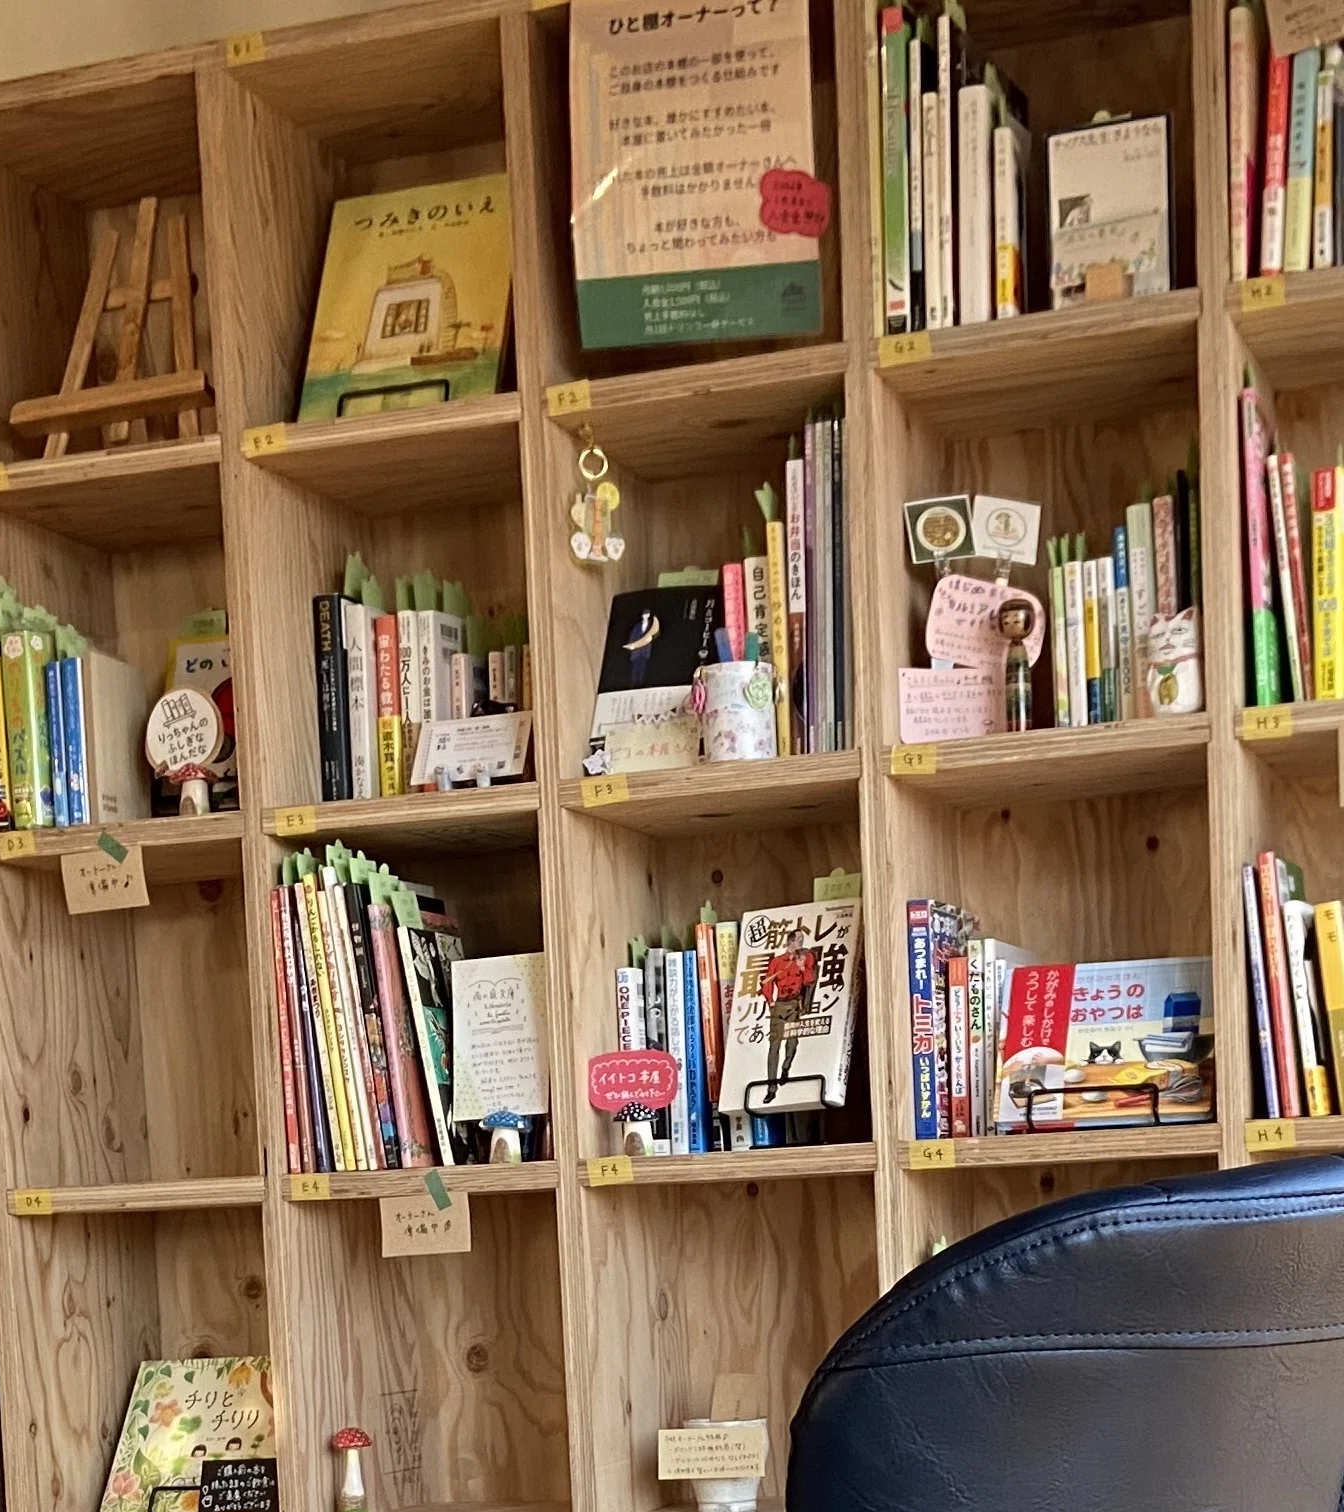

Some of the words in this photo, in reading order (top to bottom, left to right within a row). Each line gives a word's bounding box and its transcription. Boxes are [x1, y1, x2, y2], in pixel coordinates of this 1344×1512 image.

[354, 196, 497, 231] つみきのいえ
[319, 600, 333, 652] DEATH
[350, 636, 365, 712] 人間標本
[158, 717, 209, 743] りっちゃんの
[168, 733, 204, 754] ふしぎな
[168, 744, 208, 767] ほんだな
[748, 921, 768, 944] 超
[619, 985, 630, 1010] ONE
[969, 957, 982, 1032] くだものさん
[1024, 969, 1040, 1010] うつして
[1072, 982, 1145, 1002] きょうの
[913, 993, 936, 1056] トミカ
[1070, 1003, 1144, 1023] おやつは
[620, 1011, 632, 1051] PIECE
[1020, 1014, 1036, 1048] 楽しむ
[597, 1070, 661, 1086] イイトコ本屋
[918, 1055, 933, 1119] いっぱいずかん
[184, 1389, 236, 1410] チリと
[211, 1408, 263, 1434] チリリ
